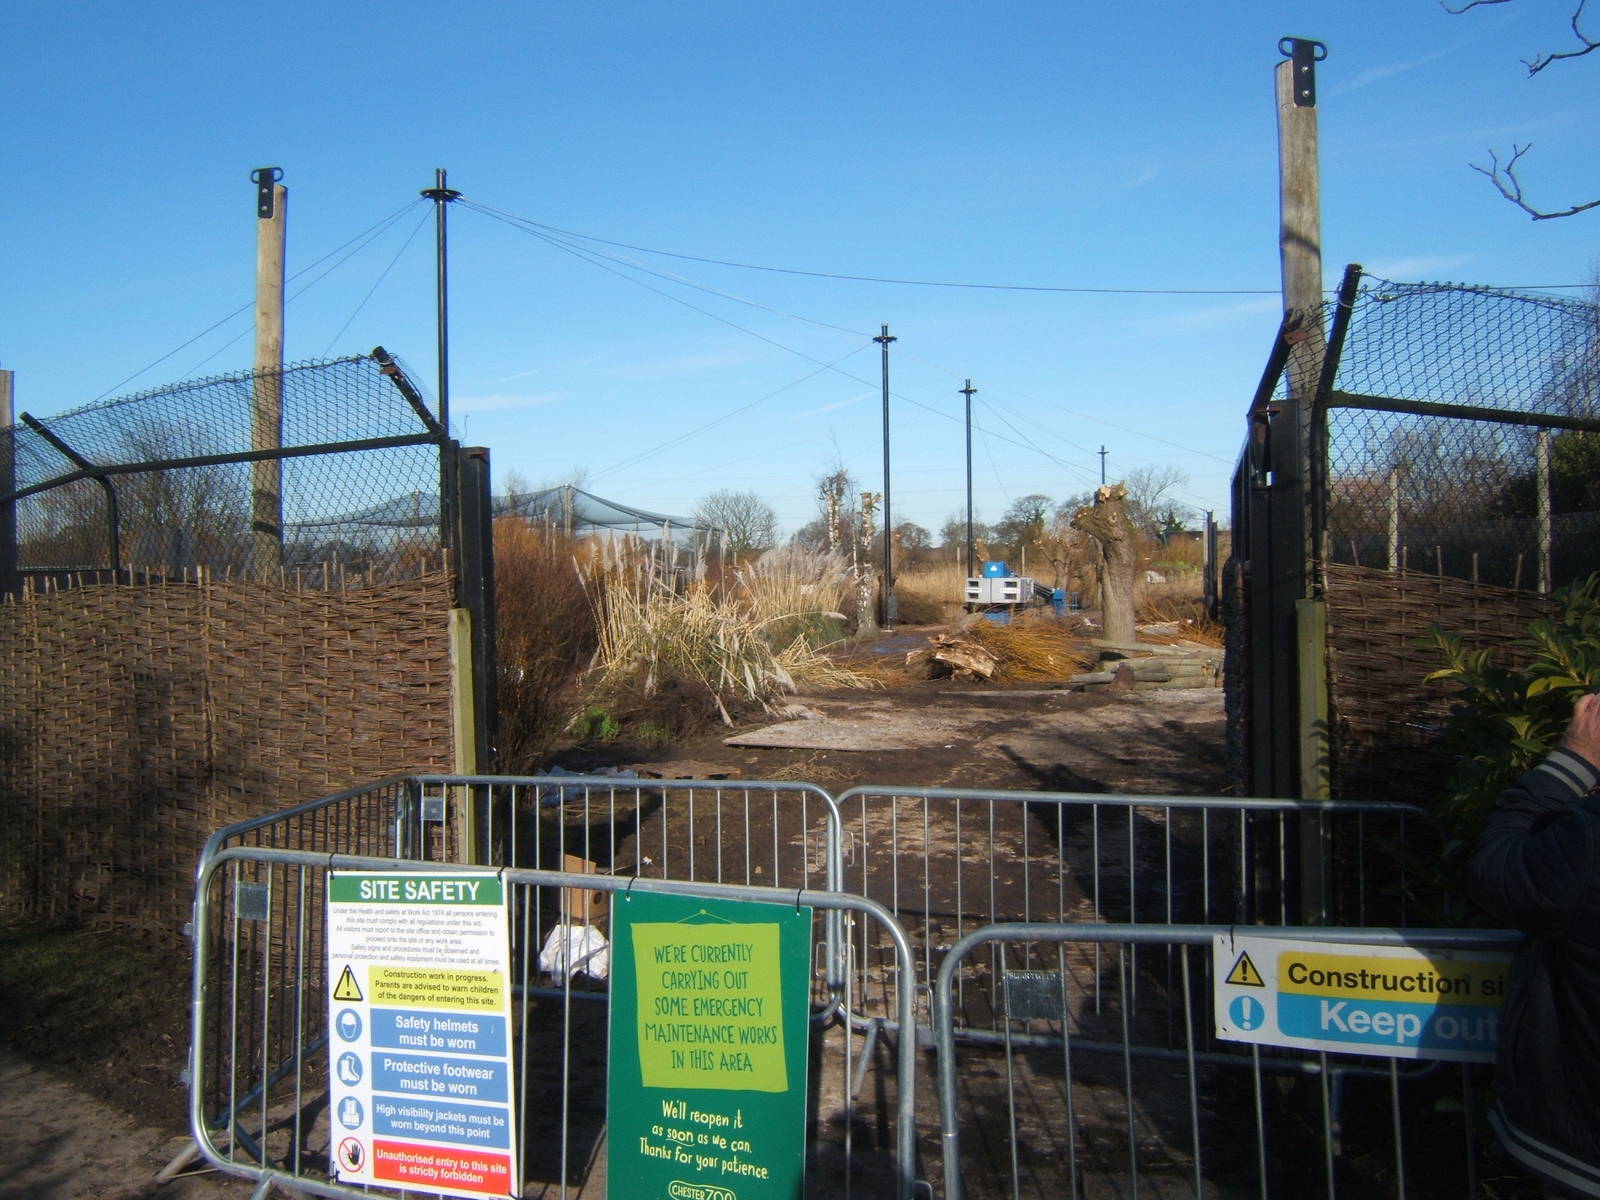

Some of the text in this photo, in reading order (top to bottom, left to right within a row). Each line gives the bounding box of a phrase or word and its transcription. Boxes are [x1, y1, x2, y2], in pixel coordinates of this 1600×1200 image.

[360, 880, 480, 900] SITE SAFETY
[691, 943, 753, 963] CURRENTLY
[384, 970, 488, 983] Construction work in progress.
[662, 970, 748, 990] CARRYING OUT
[1288, 963, 1470, 996] Construction
[376, 981, 400, 989] Parents
[414, 982, 440, 991] advised
[470, 985, 498, 994] children
[398, 992, 426, 1002] dangers
[436, 995, 464, 1005] entering
[466, 996, 479, 1004] this
[481, 997, 496, 1006] site.
[655, 997, 763, 1017] SOME EMERGENCY
[396, 1016, 479, 1033] Safety helmets
[1321, 1000, 1499, 1043] Keep out
[400, 1033, 476, 1050] must be worn
[645, 1024, 777, 1044] MAINTENANCE WORKS
[384, 1058, 494, 1080] Protective footwear
[672, 1050, 753, 1072] IN THIS AREA
[400, 1078, 477, 1095] must be worn
[376, 1104, 504, 1126] High visibility jackets must be
[662, 1100, 743, 1129] We'll reopen it
[391, 1119, 490, 1138] worn beyond this point
[652, 1125, 752, 1153] as soon as we can.
[377, 1149, 507, 1174] Unauthorised entry to this site
[640, 1137, 769, 1179] Thanks for your patience.
[400, 1164, 483, 1183] is strictly forbidden
[672, 1185, 732, 1200] CHESTER ZOO
